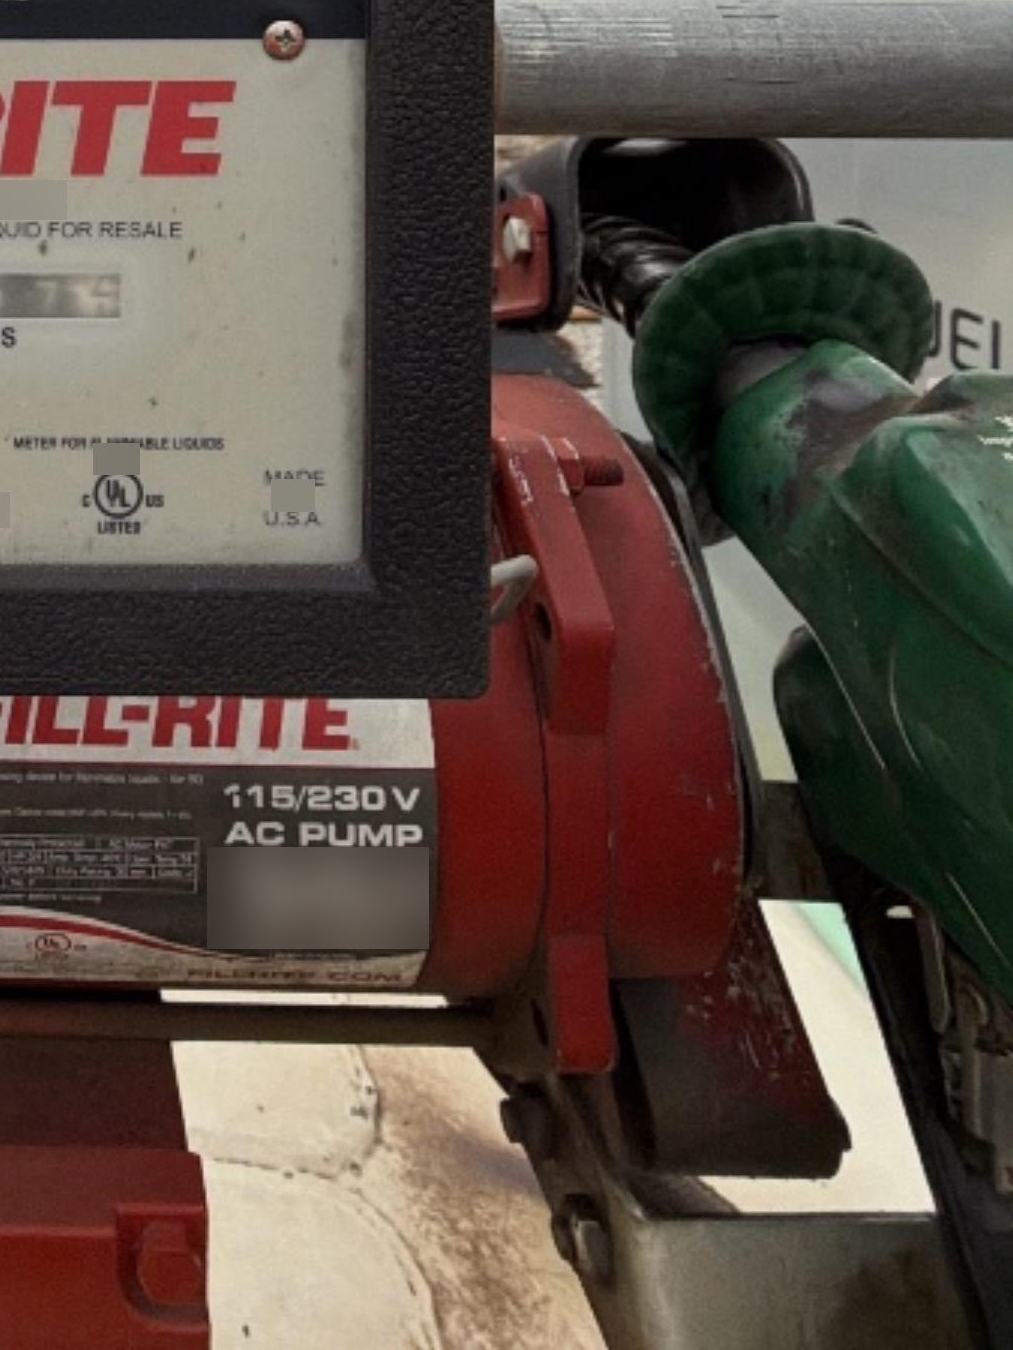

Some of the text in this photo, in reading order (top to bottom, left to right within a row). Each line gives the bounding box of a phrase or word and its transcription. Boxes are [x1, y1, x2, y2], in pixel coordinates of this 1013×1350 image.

[47, 221, 93, 239] FOR
[99, 220, 183, 239] RESALE
[13, 436, 57, 450] METER
[61, 436, 87, 450] FOR
[172, 436, 226, 450] LIQUIDS
[97, 520, 142, 536] LISTED
[223, 784, 421, 813] 115/230 V
[224, 821, 424, 847] AC PUMP
